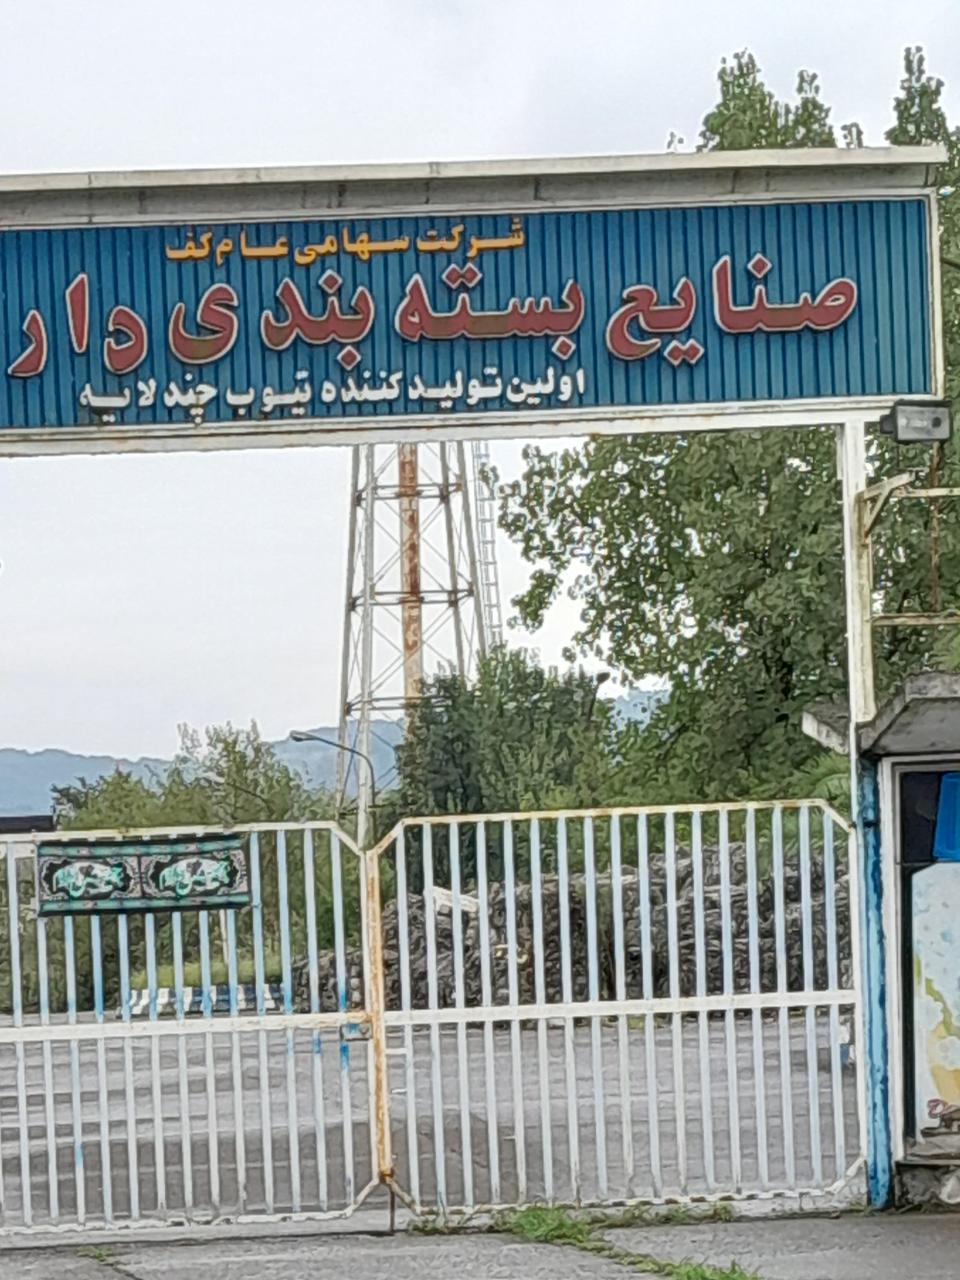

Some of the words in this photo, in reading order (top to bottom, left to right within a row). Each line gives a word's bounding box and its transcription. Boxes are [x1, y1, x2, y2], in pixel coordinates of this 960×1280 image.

[293, 227, 410, 266] سهامی
[416, 217, 525, 258] شرکت
[168, 268, 376, 372] بندی
[393, 262, 586, 361] بسته
[605, 252, 859, 367] صنایع
[225, 370, 313, 416] تیوب
[320, 369, 404, 403] کننده
[407, 366, 503, 408] تولید
[506, 366, 586, 406] اولین
